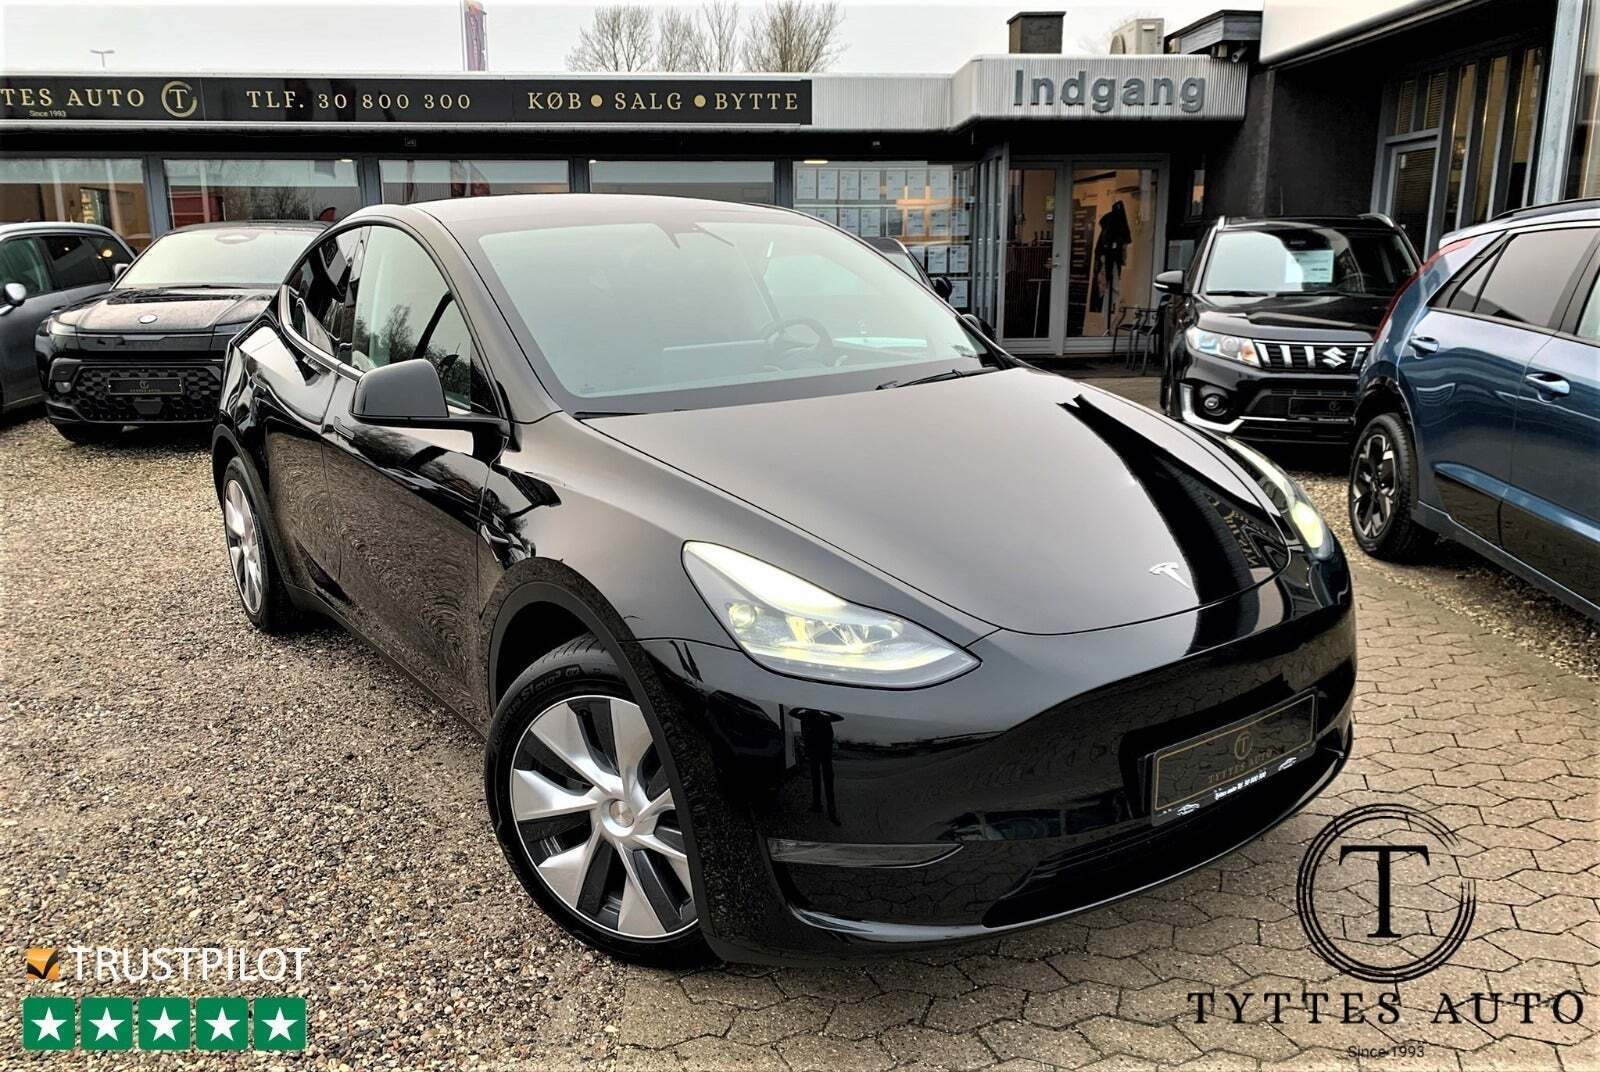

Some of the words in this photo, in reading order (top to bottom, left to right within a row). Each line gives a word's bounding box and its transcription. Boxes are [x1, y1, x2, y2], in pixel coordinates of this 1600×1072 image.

[66, 88, 145, 107] AUTO
[246, 90, 304, 108] TLF.
[318, 94, 347, 109] 30
[362, 94, 409, 109] 800
[424, 94, 470, 110] 300
[1013, 69, 1206, 113] Indgang
[527, 92, 582, 110] KØB
[614, 92, 682, 110] SALG
[715, 92, 798, 110] BYTTE
[29, 109, 48, 118] Since
[49, 109, 67, 118] 1993
